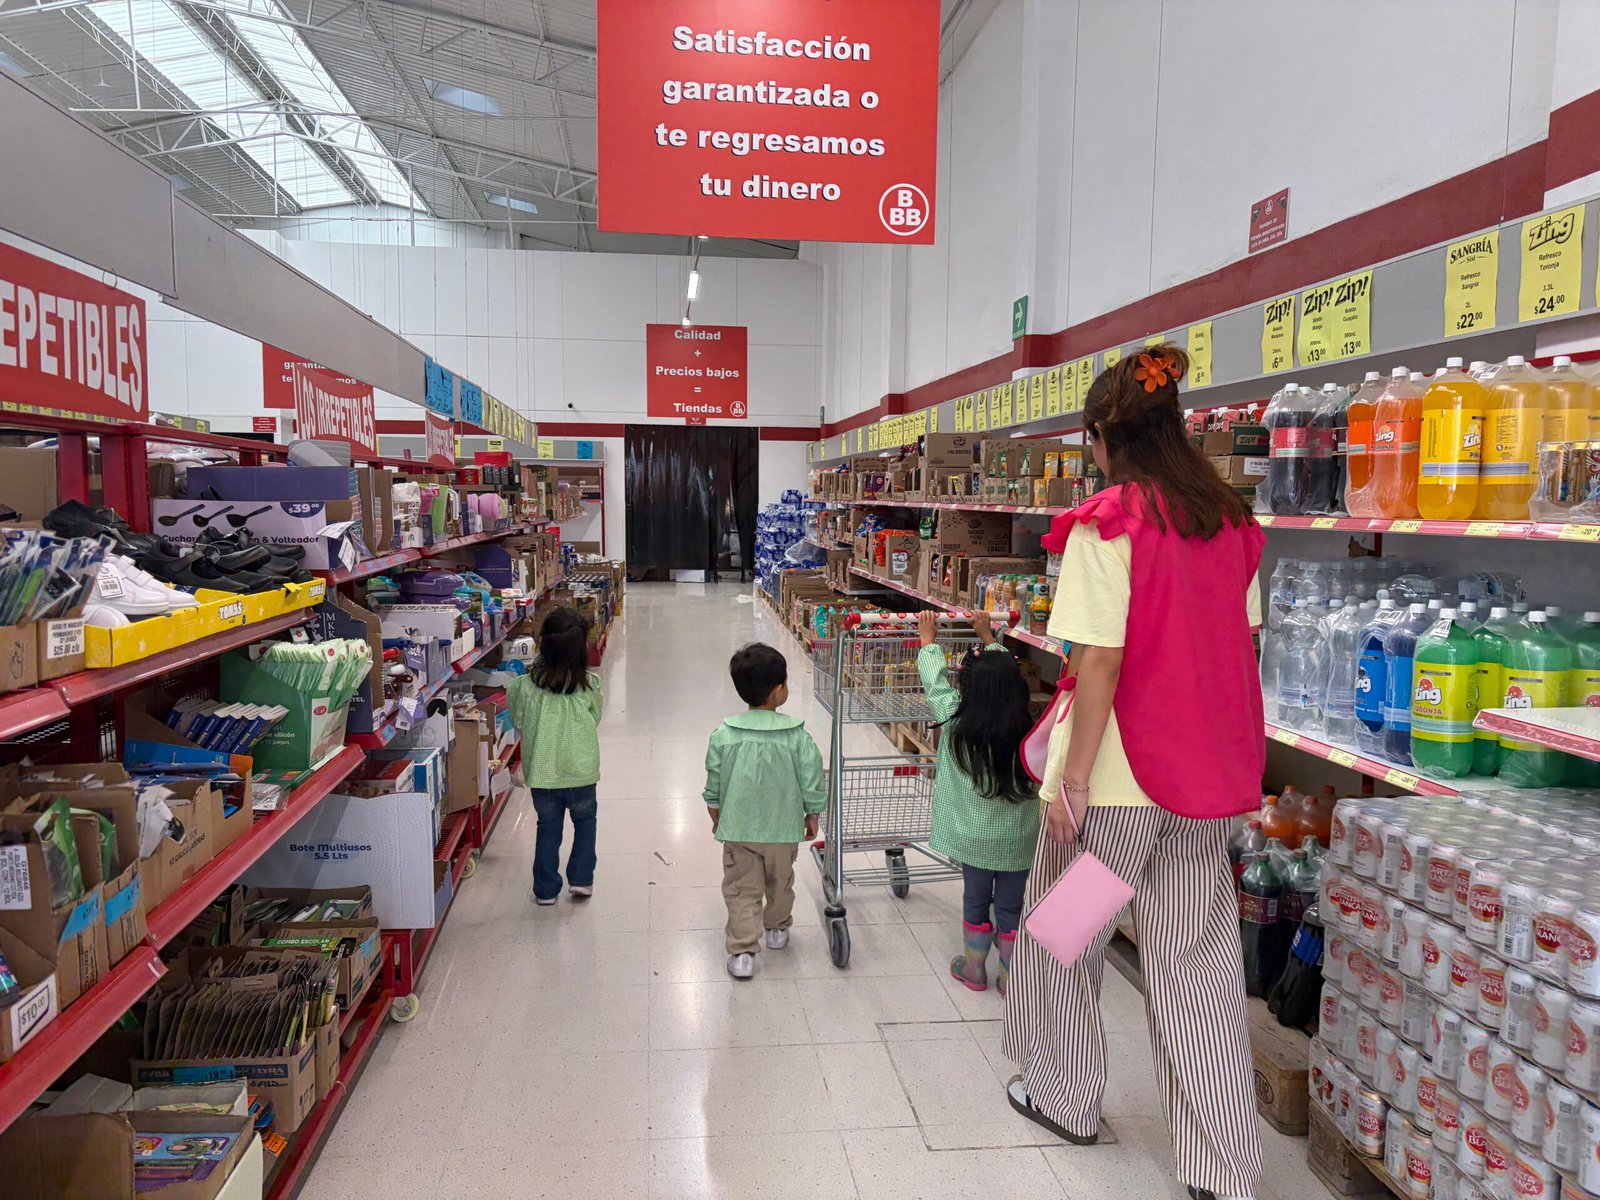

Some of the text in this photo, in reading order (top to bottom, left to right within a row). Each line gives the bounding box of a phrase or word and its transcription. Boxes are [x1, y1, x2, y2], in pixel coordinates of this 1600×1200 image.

[672, 25, 871, 62] Satisfacción
[662, 79, 880, 110] garantizada o
[655, 122, 886, 157] te regresamos
[700, 173, 841, 202] tu dinero
[1450, 236, 1493, 265] SANGRÍA
[1538, 250, 1562, 262] Refresco
[1539, 261, 1560, 272] Toronja
[1304, 287, 1333, 316] Zip!
[1335, 276, 1369, 307] Zip!
[1266, 298, 1291, 325] Zip!
[674, 329, 721, 341] Calidad
[655, 365, 740, 380] Precios bajos
[316, 387, 374, 451] IRREPETIBLES
[673, 402, 722, 414] Tiendas
[290, 843, 372, 852] Bote Multiusos
[314, 852, 348, 860] 5.5 Lts
